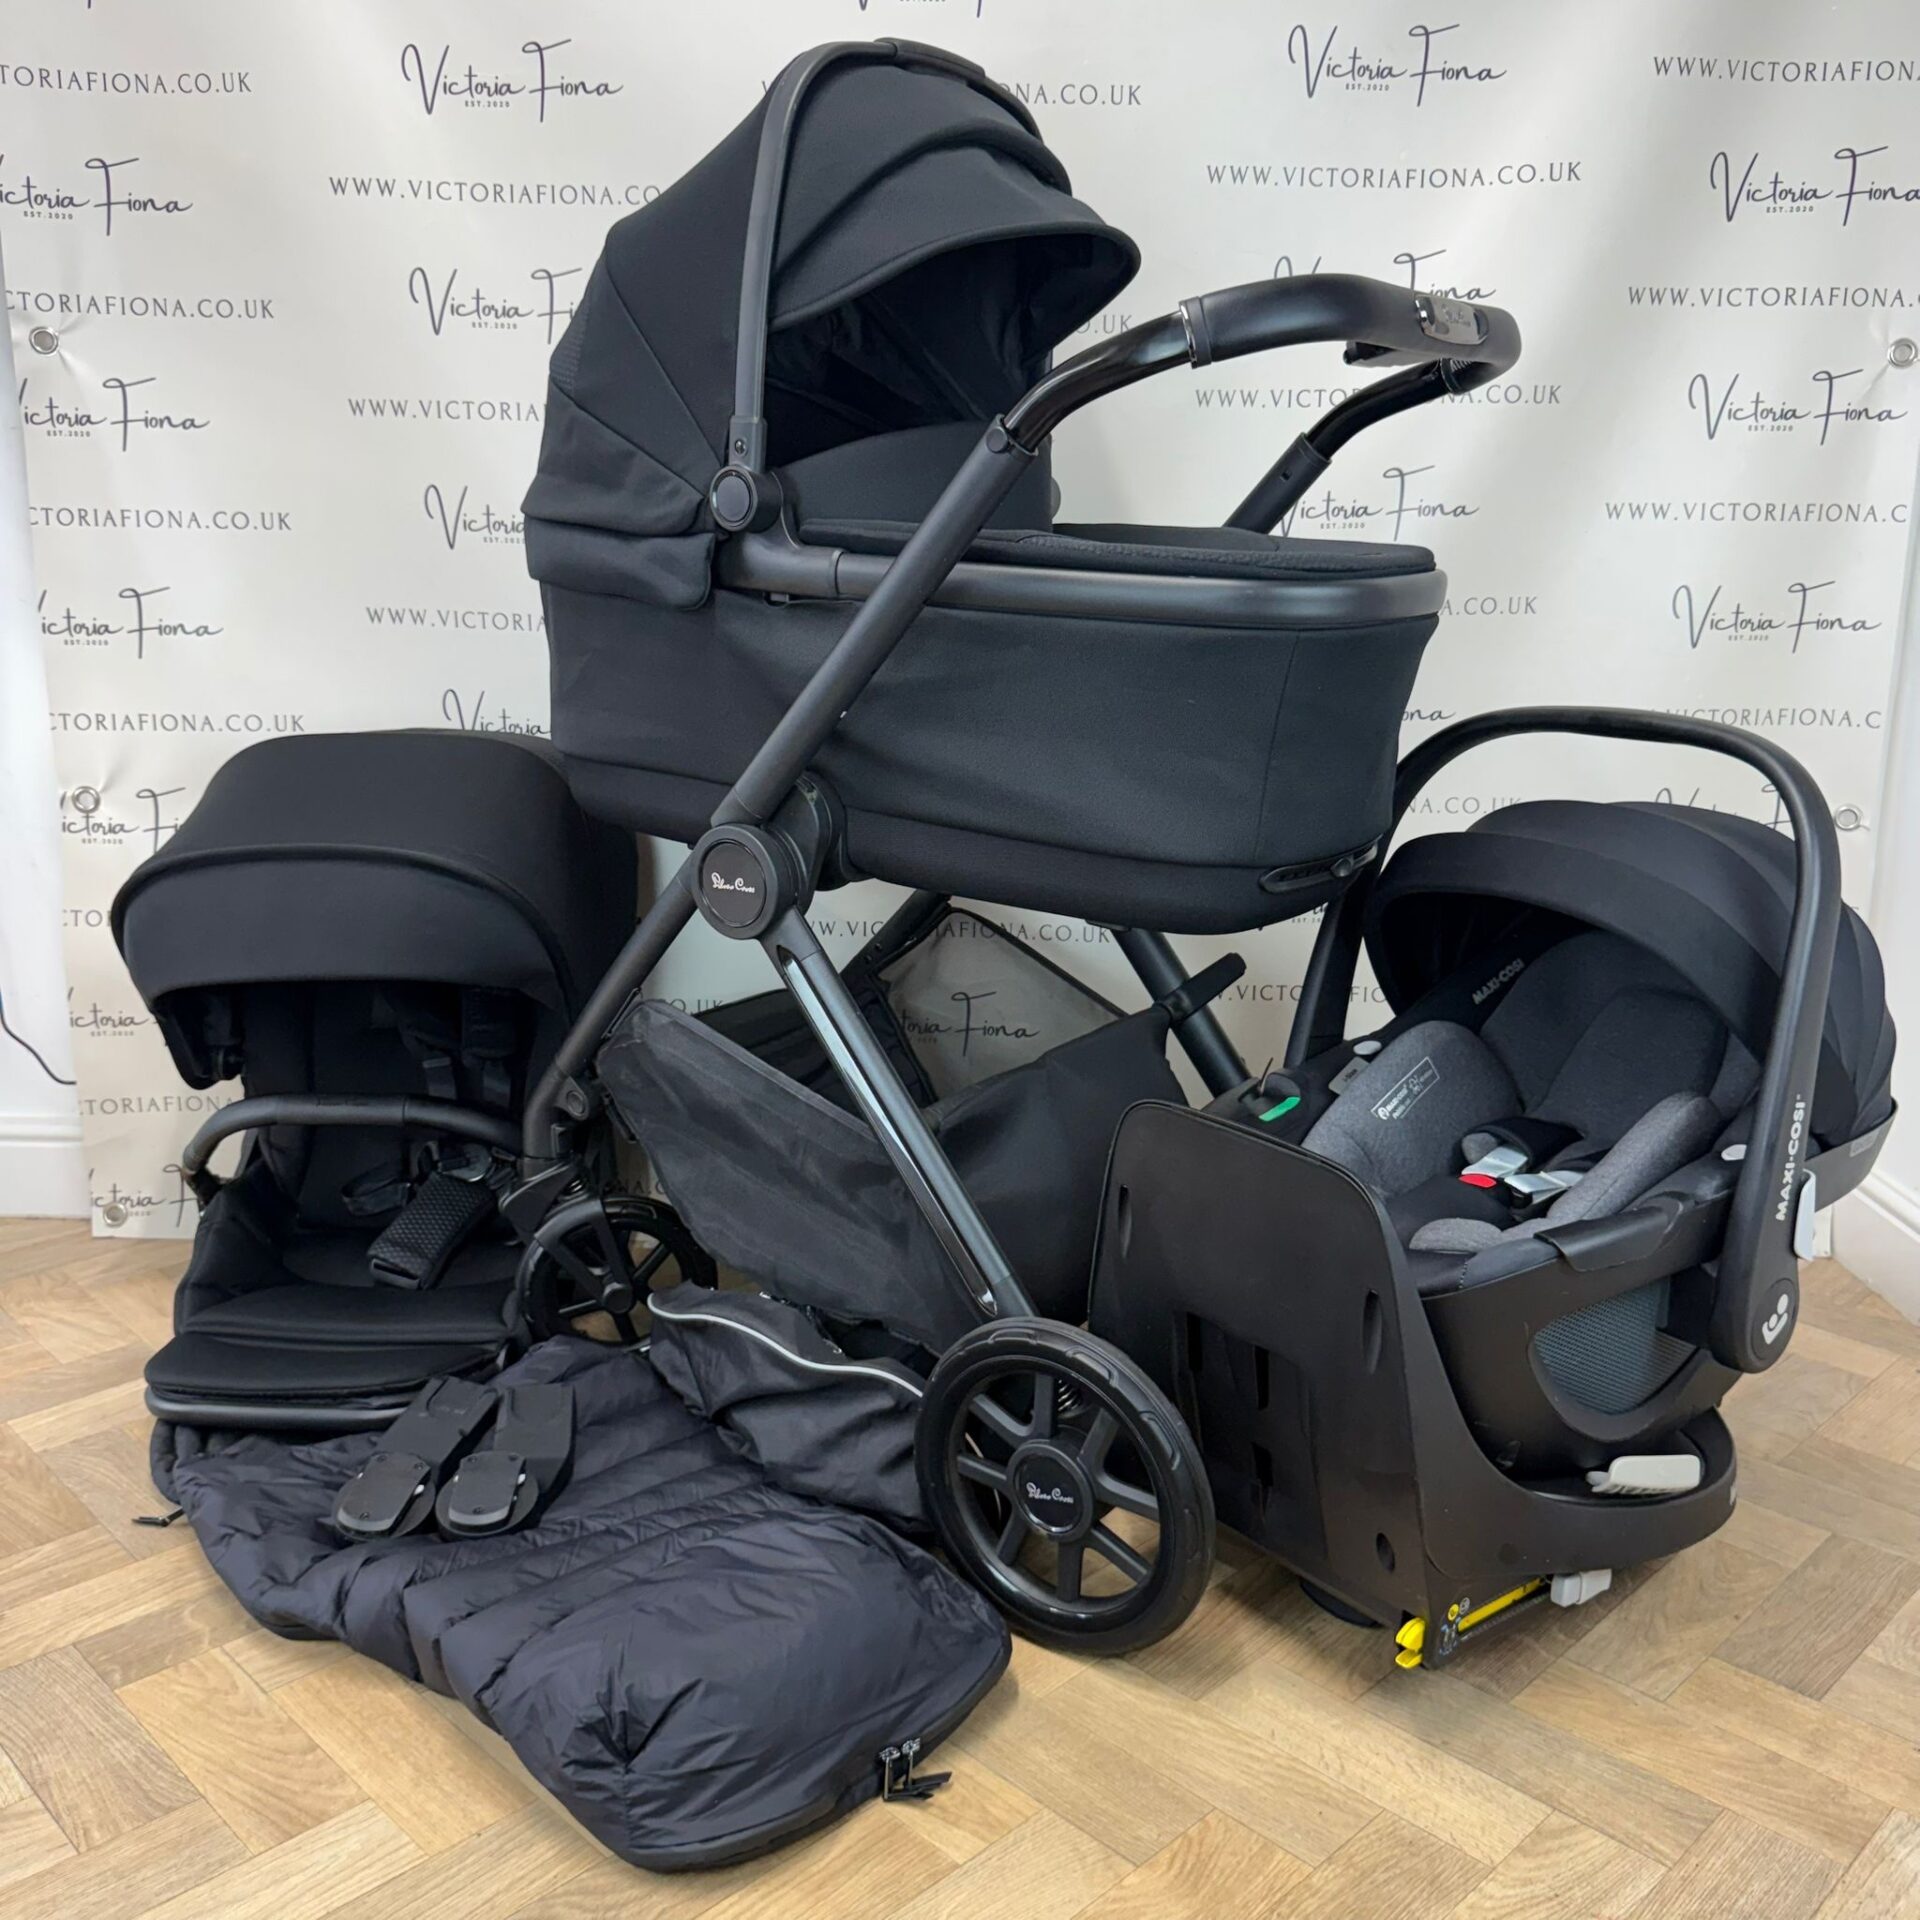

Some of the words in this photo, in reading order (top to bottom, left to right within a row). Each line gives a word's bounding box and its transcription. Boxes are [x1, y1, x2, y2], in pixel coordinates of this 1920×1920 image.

[401, 44, 525, 115] Victoria
[522, 38, 624, 122] Fiona
[1288, 24, 1408, 98] Victoria
[1408, 24, 1507, 107] Fiona
[1653, 56, 1920, 82] WWW.VICTORIAFION
[0, 154, 90, 209] ictoria
[85, 158, 193, 236] Fiona
[1206, 162, 1582, 189] WWW.VICTORIAFIONA.CO.UK
[1710, 152, 1833, 222] Victoria
[1834, 146, 1920, 226] Fiona
[408, 267, 534, 336] Victoria
[1628, 286, 1920, 307] WWW.VICTORIAFIONA.
[19, 378, 107, 428] ictoria
[103, 377, 210, 452] Fiona
[348, 398, 547, 422] WWW.VICTORIA
[1689, 373, 1811, 440] Victoria
[1812, 368, 1908, 446] Fiona
[1383, 465, 1480, 541] Fiona
[38, 589, 124, 638] ictoria
[119, 586, 224, 659] Fiona
[1673, 585, 1785, 649] Victoria
[1787, 580, 1881, 653] Fiona
[60, 791, 139, 836] ictoria
[68, 987, 150, 1029] ictoria
[951, 991, 1040, 1057] Fiona
[89, 1168, 167, 1208] ictoria
